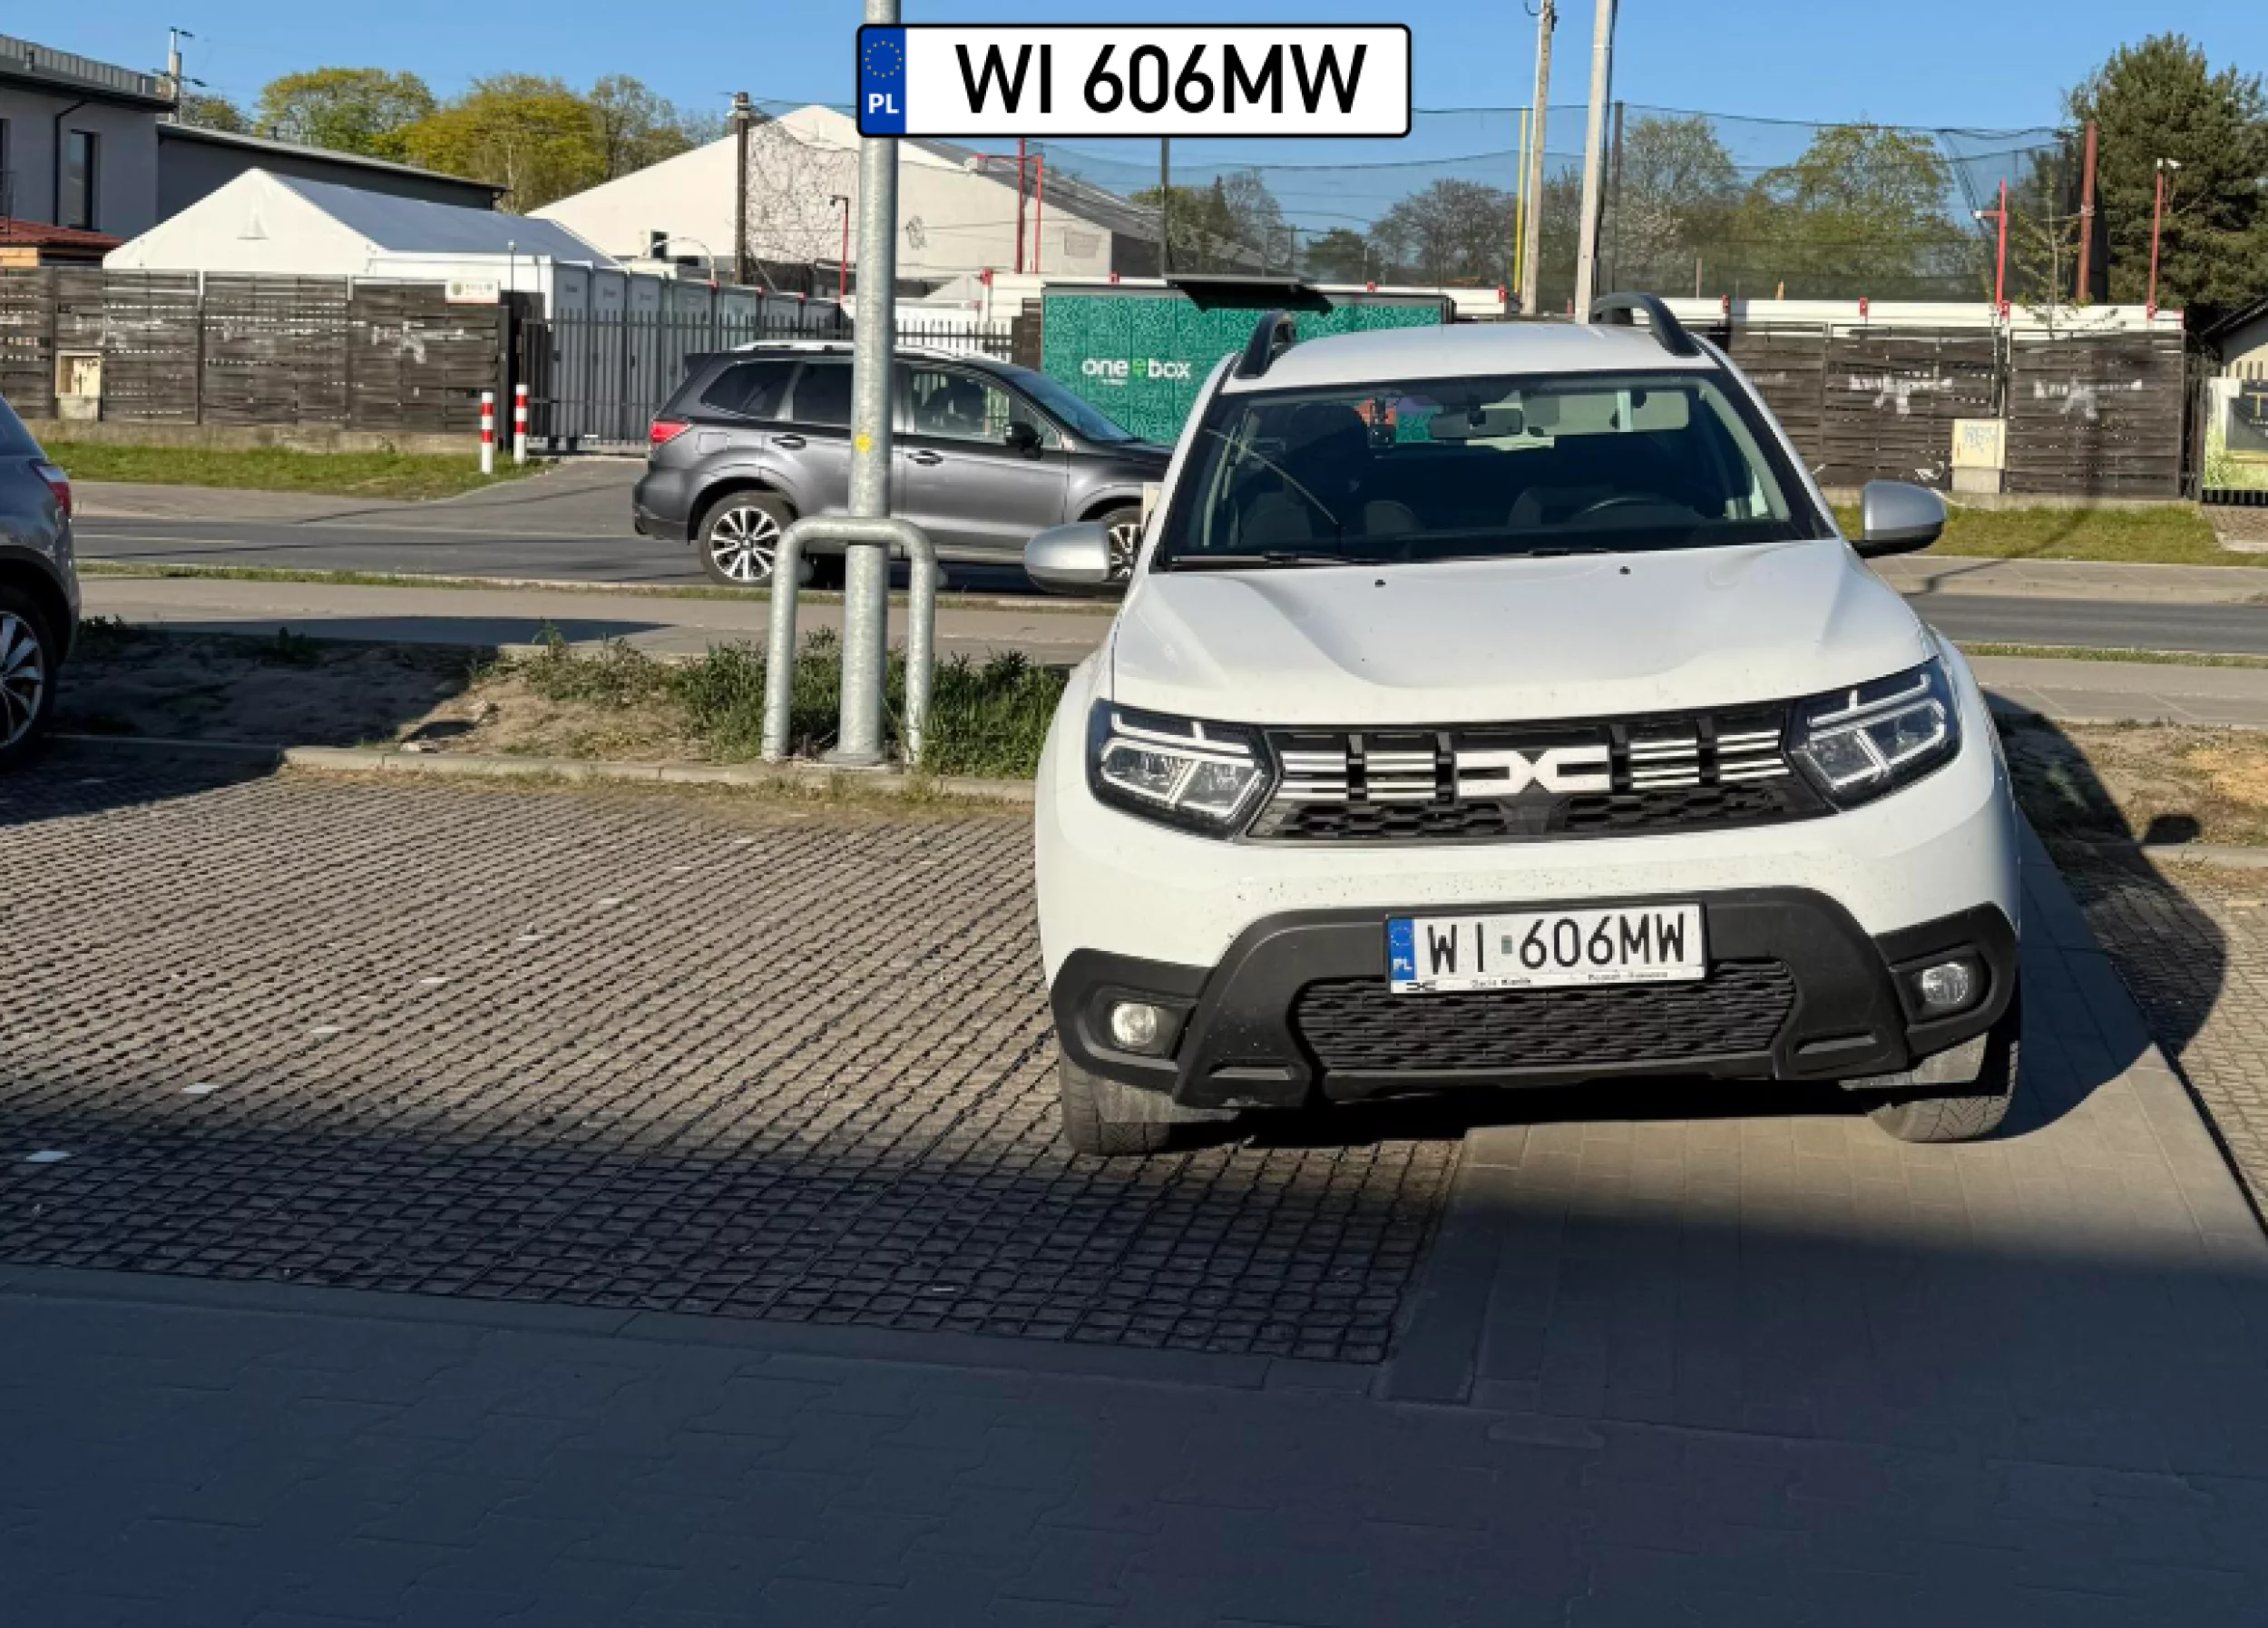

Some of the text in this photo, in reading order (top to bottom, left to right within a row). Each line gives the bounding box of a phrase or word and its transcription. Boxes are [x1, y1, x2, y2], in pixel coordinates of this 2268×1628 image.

[1082, 358, 1191, 379] one box
[1427, 911, 1684, 976] WI 606MW
[1393, 957, 1413, 971] PL
